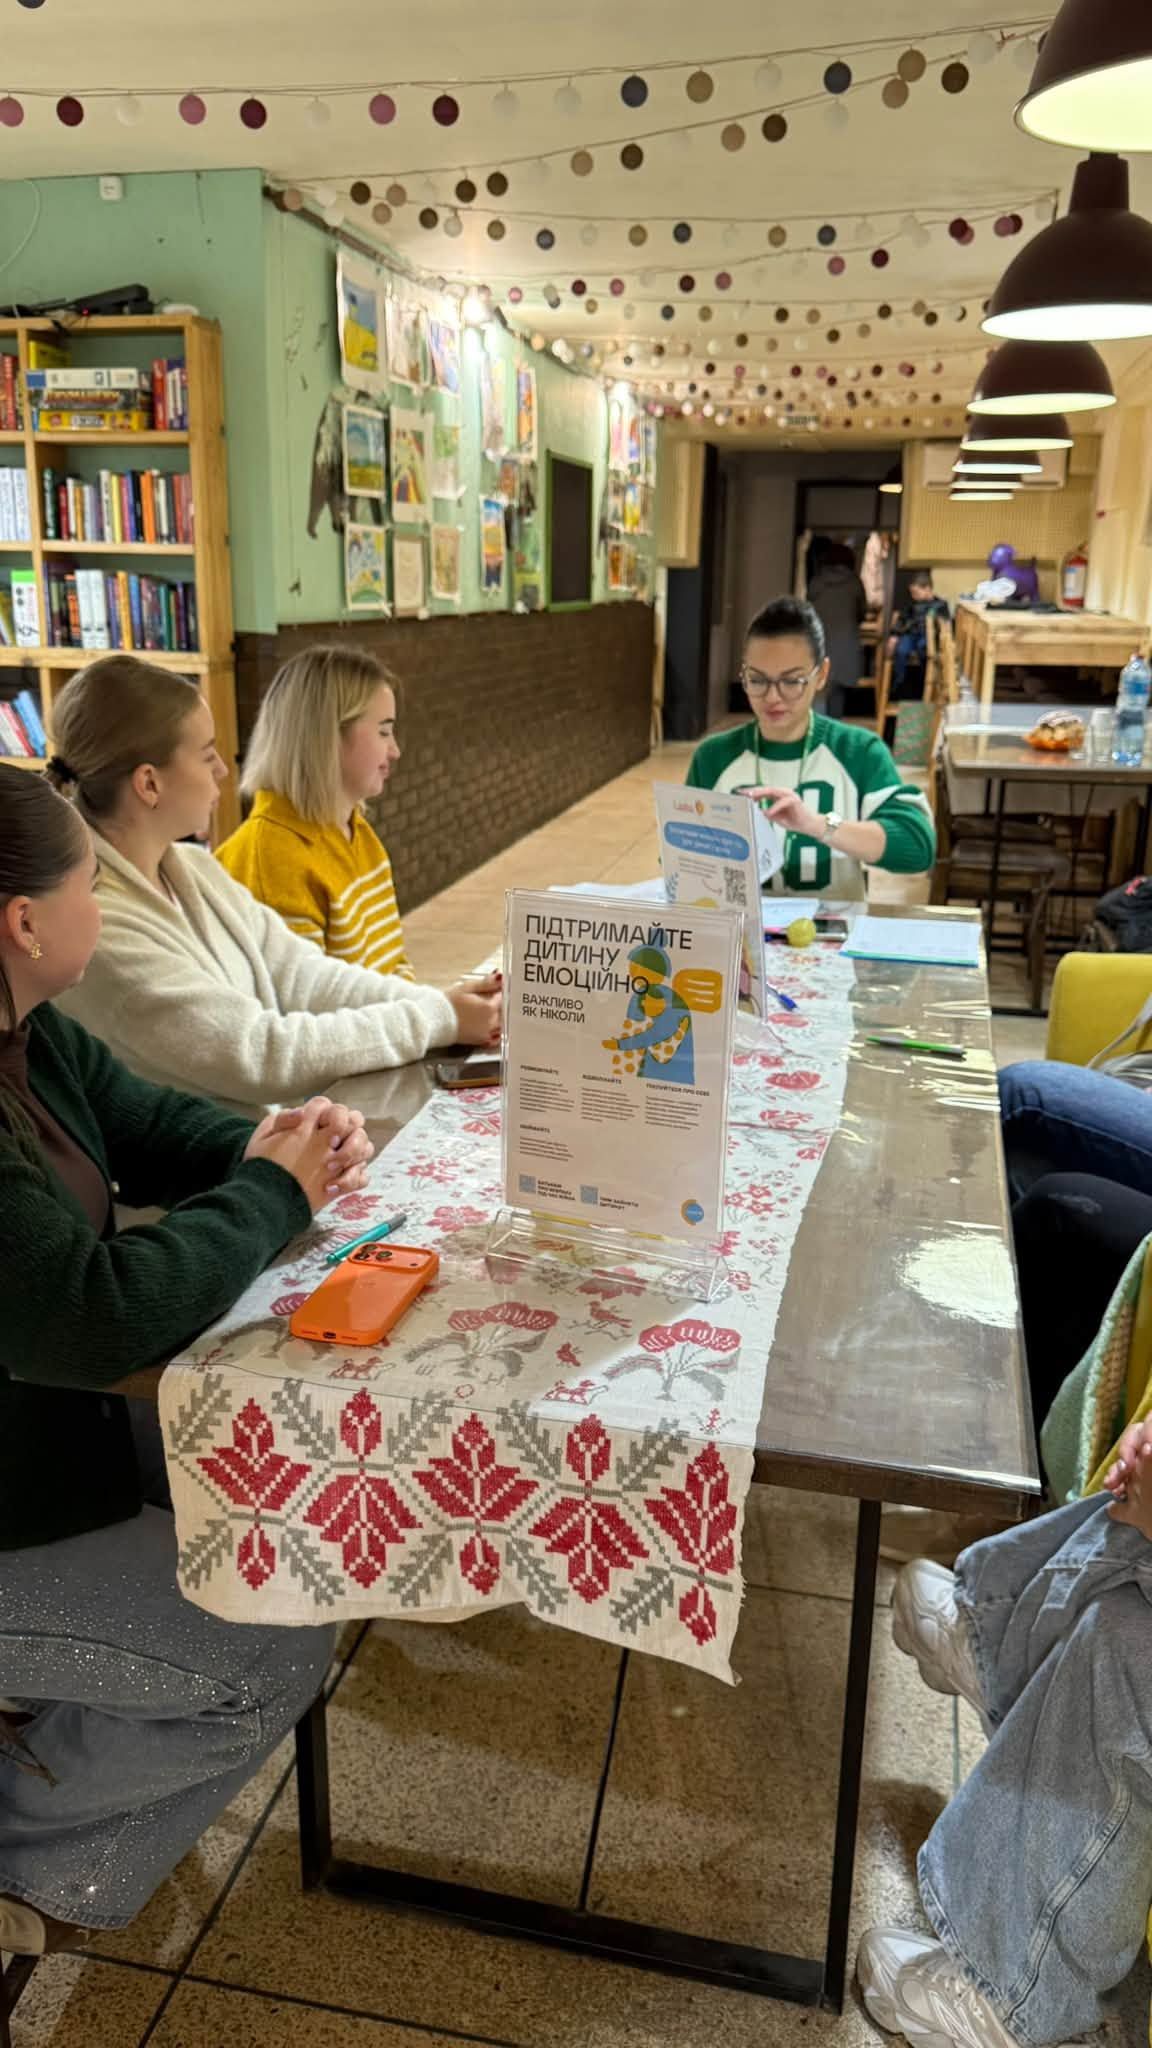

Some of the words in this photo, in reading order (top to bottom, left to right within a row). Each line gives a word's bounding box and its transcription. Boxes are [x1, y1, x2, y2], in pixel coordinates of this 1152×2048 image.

[526, 914, 693, 950] ПІДТРИМАЙТЕ
[524, 939, 620, 966] ДИТИНУ
[524, 963, 649, 995] ЕМОЦІЙНО
[522, 993, 584, 1010] ВАЖЛИВО
[522, 1006, 537, 1017] ЯК
[540, 1008, 585, 1023] НІКОЛИ
